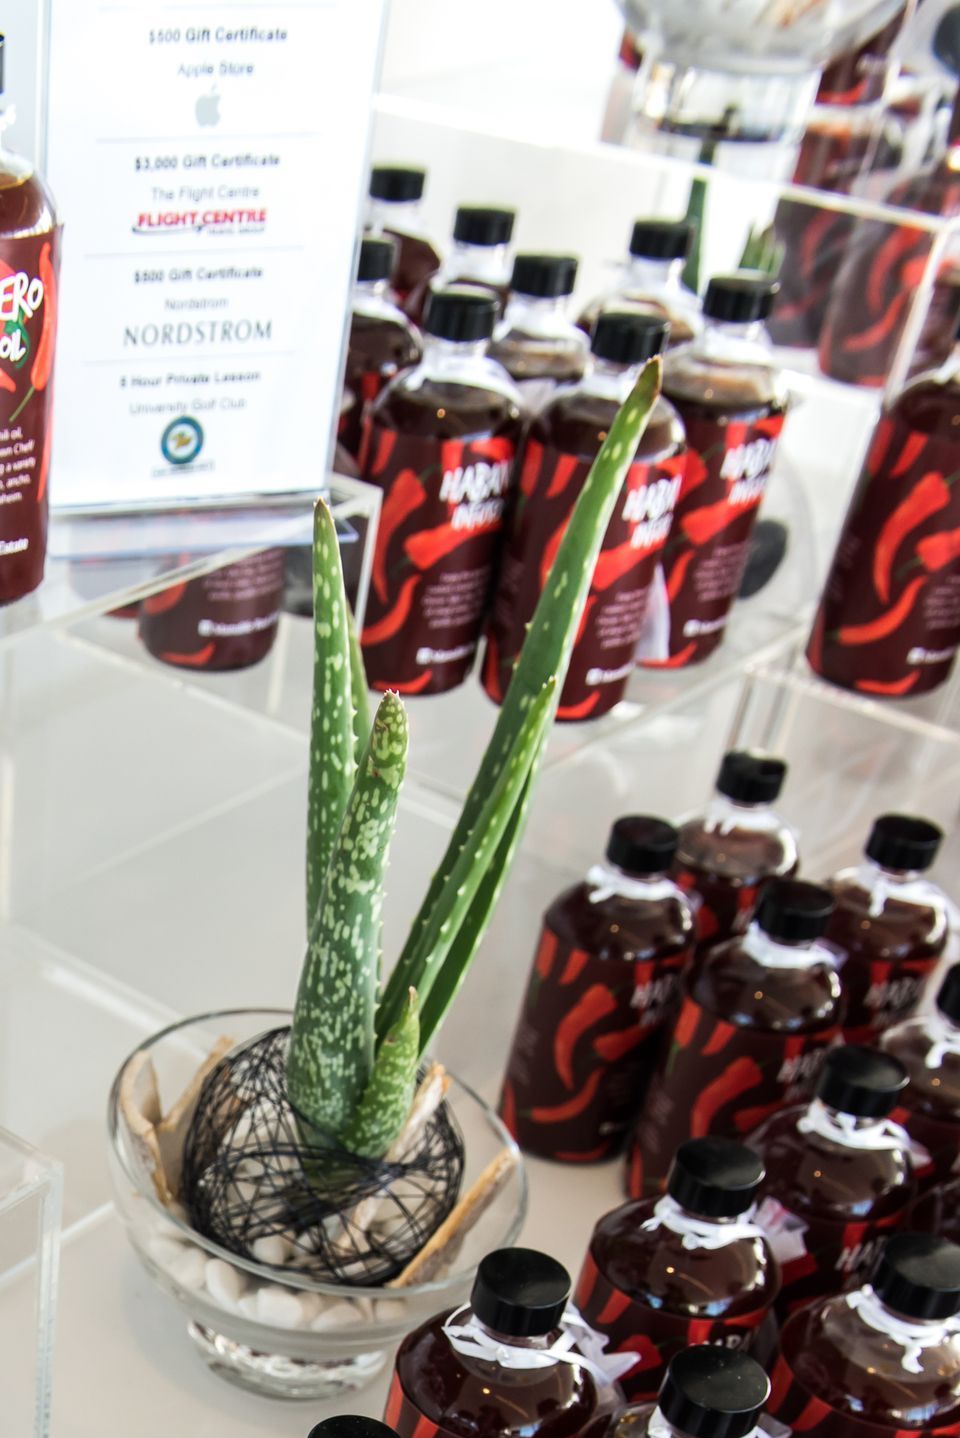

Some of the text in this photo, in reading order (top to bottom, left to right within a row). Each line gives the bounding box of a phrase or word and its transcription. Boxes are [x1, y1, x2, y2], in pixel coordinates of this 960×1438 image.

[186, 27, 210, 43] Gift
[215, 26, 287, 42] Certificate
[178, 60, 254, 78] Apple Store
[183, 155, 207, 169] Gift
[211, 153, 280, 168] Certificate
[152, 184, 259, 203] The Flight Centre
[138, 208, 267, 227] FLIGHT CENTRE
[169, 266, 263, 282] Gift Certificate
[165, 298, 229, 311] Nordstrom
[123, 319, 272, 347] NORDSTROM
[129, 396, 247, 416] University Golf Club
